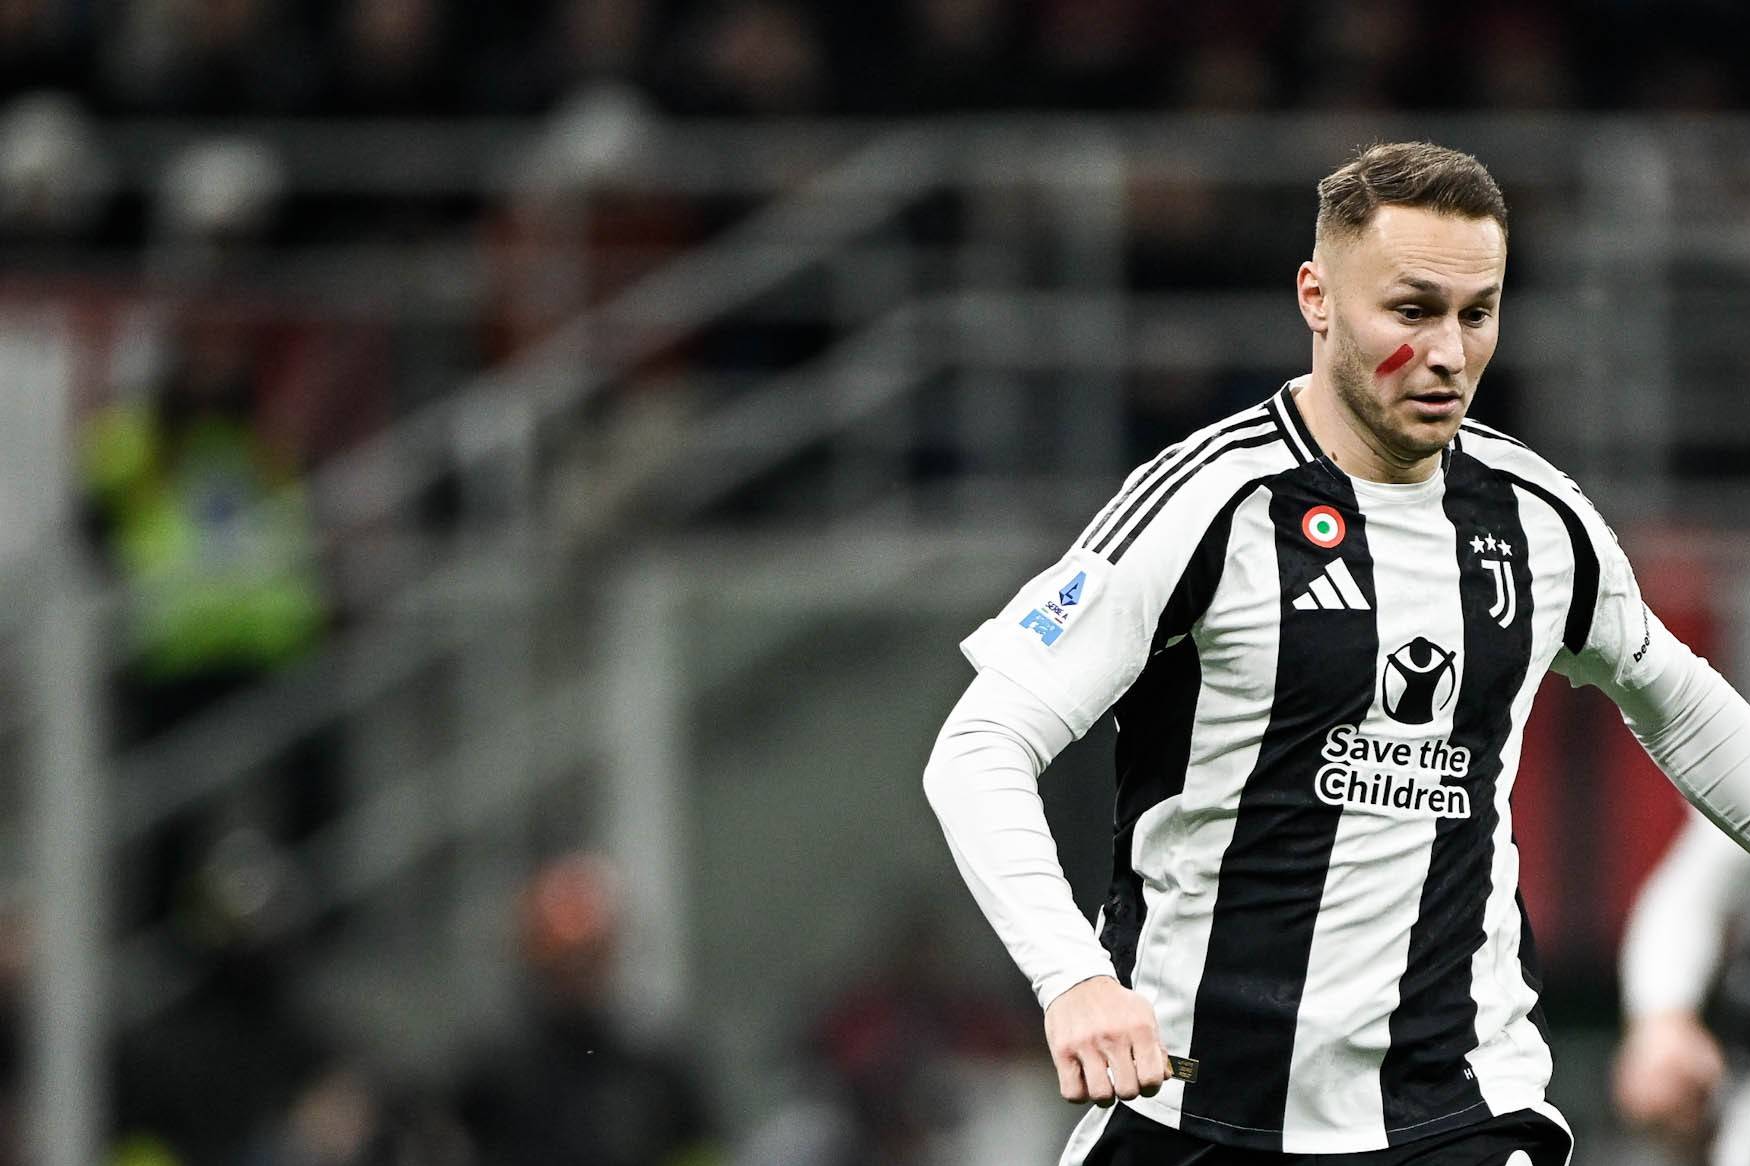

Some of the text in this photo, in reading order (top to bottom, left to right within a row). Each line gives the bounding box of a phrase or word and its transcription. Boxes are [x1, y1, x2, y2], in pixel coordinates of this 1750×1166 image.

[1326, 727, 1466, 772] Save the
[1319, 767, 1465, 813] Children
